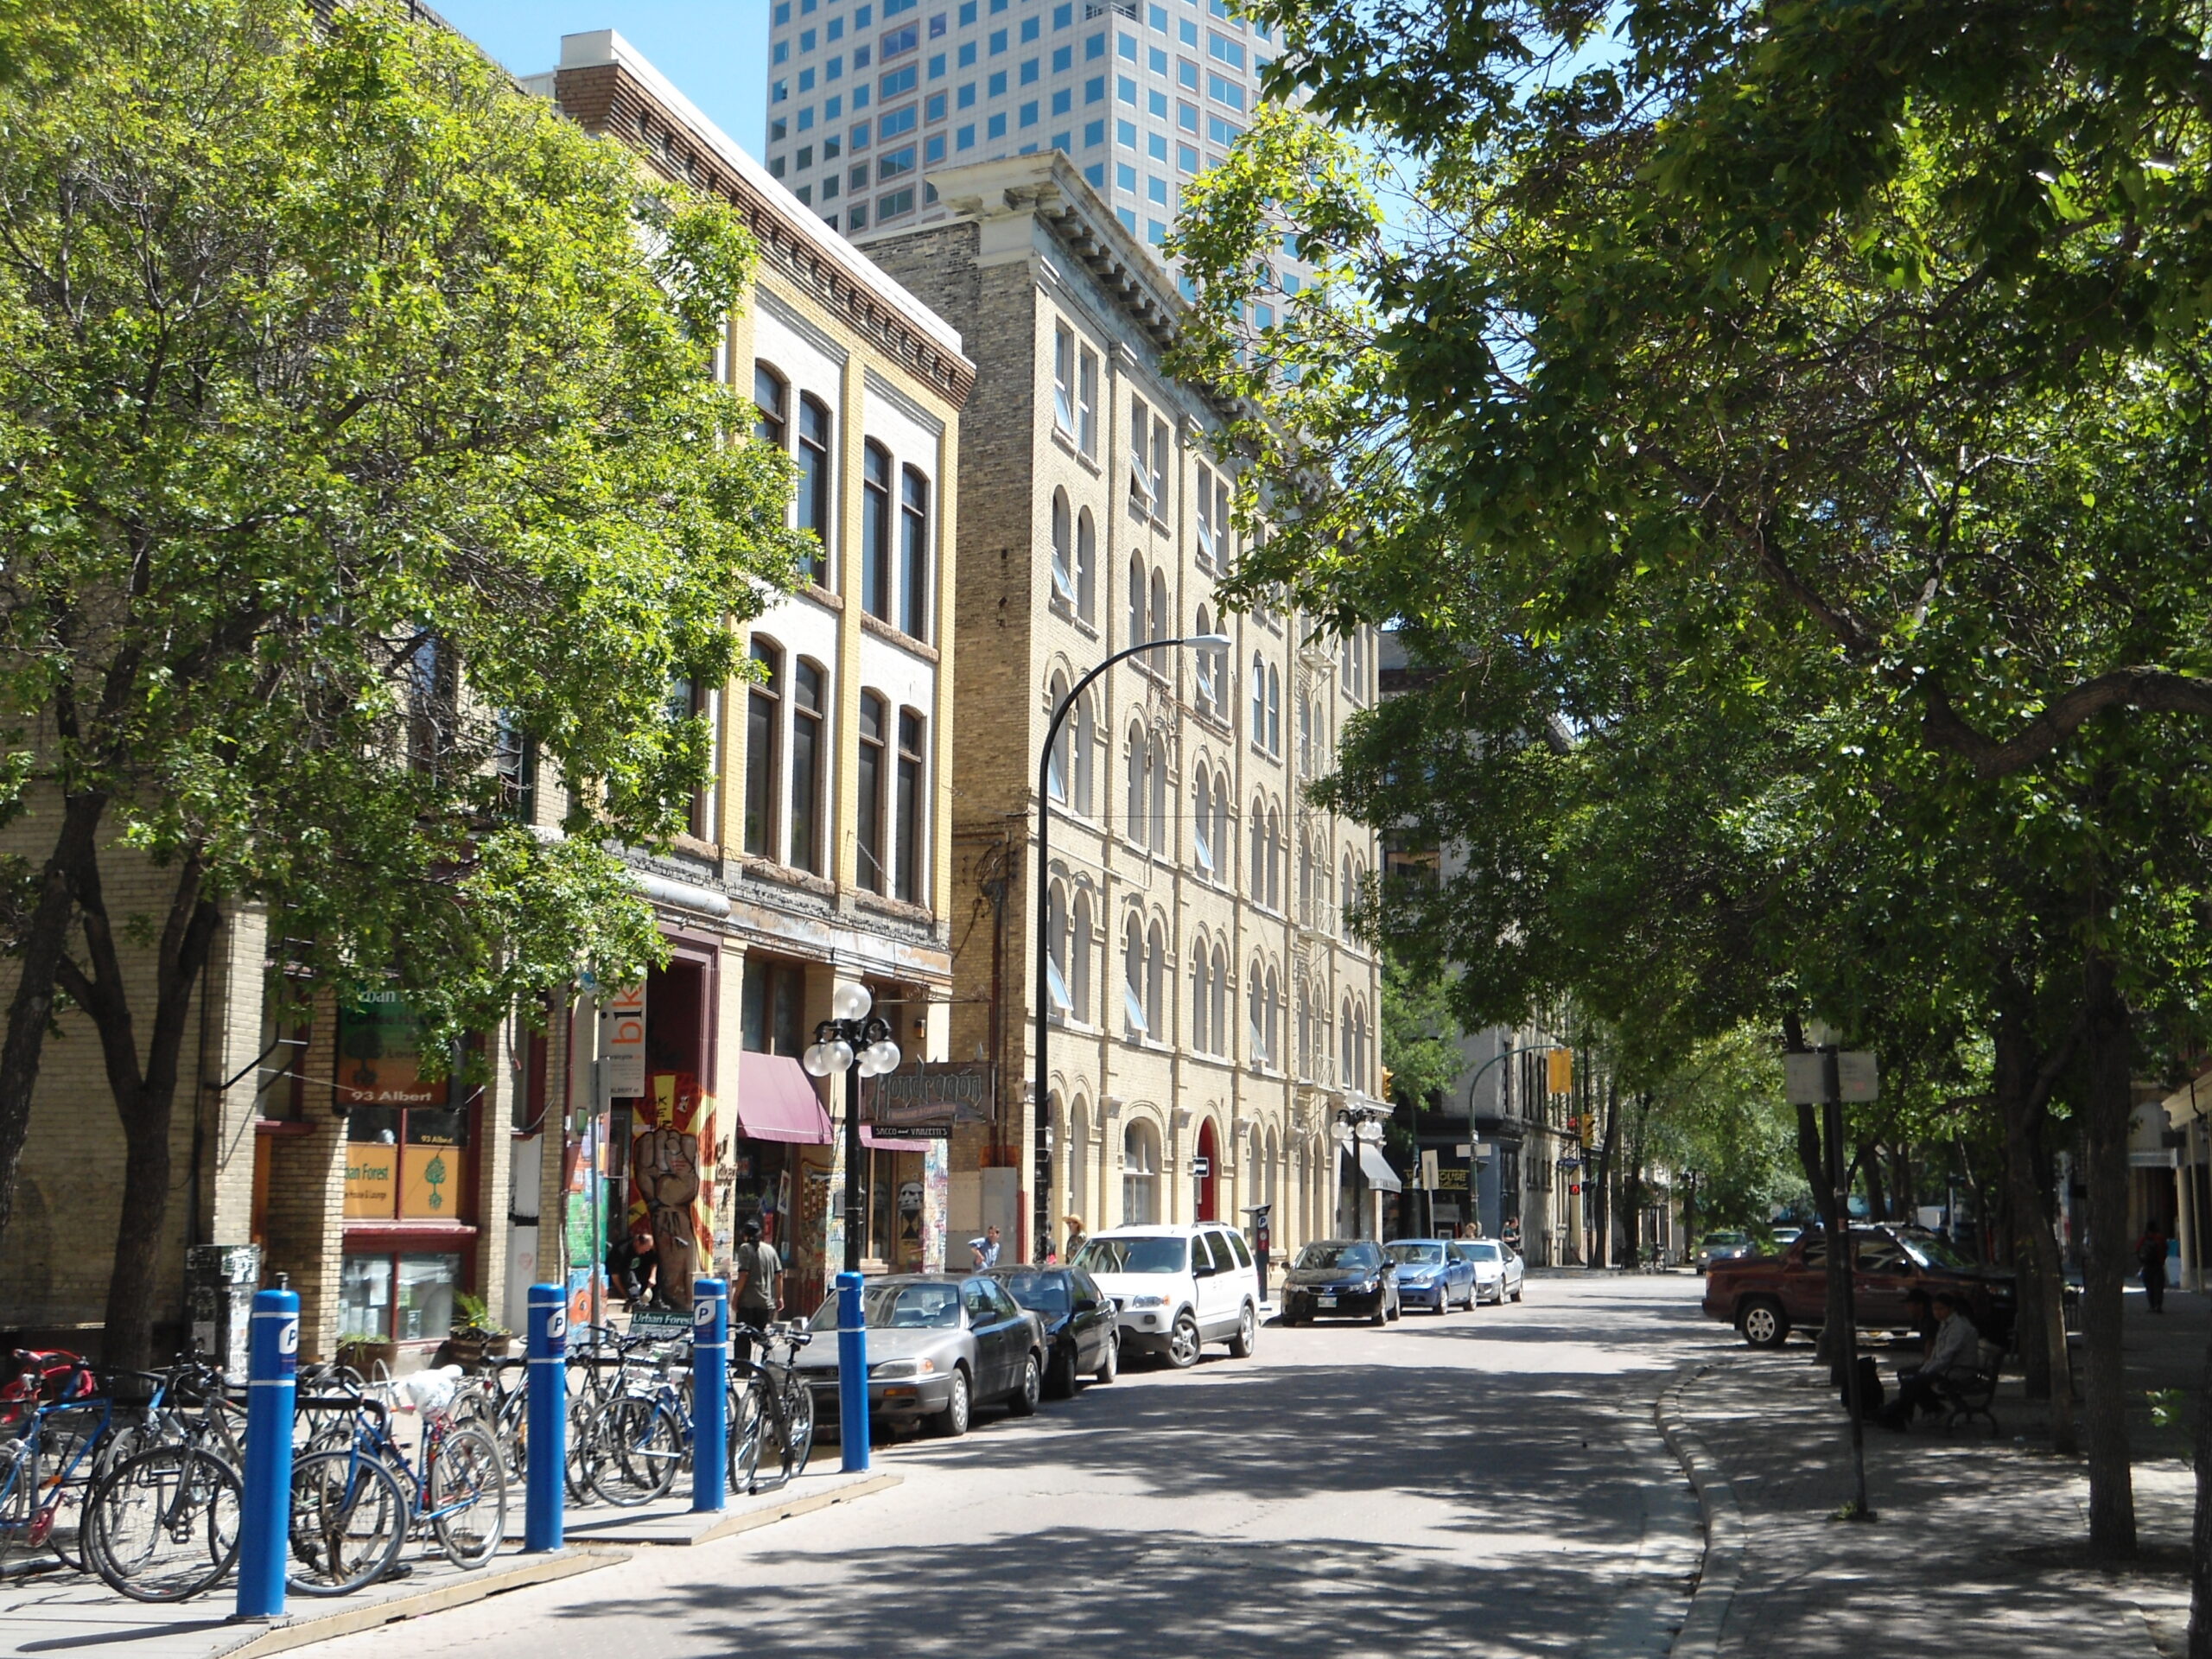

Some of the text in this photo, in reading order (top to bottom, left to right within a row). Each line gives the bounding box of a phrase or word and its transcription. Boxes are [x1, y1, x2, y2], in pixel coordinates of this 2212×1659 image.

[601, 984, 643, 1044] bik
[351, 1090, 432, 1102] 93 Albert
[362, 1163, 389, 1180] Forest
[633, 1313, 694, 1325] Urban Forest
[697, 1307, 709, 1320] P
[554, 1317, 563, 1332] P
